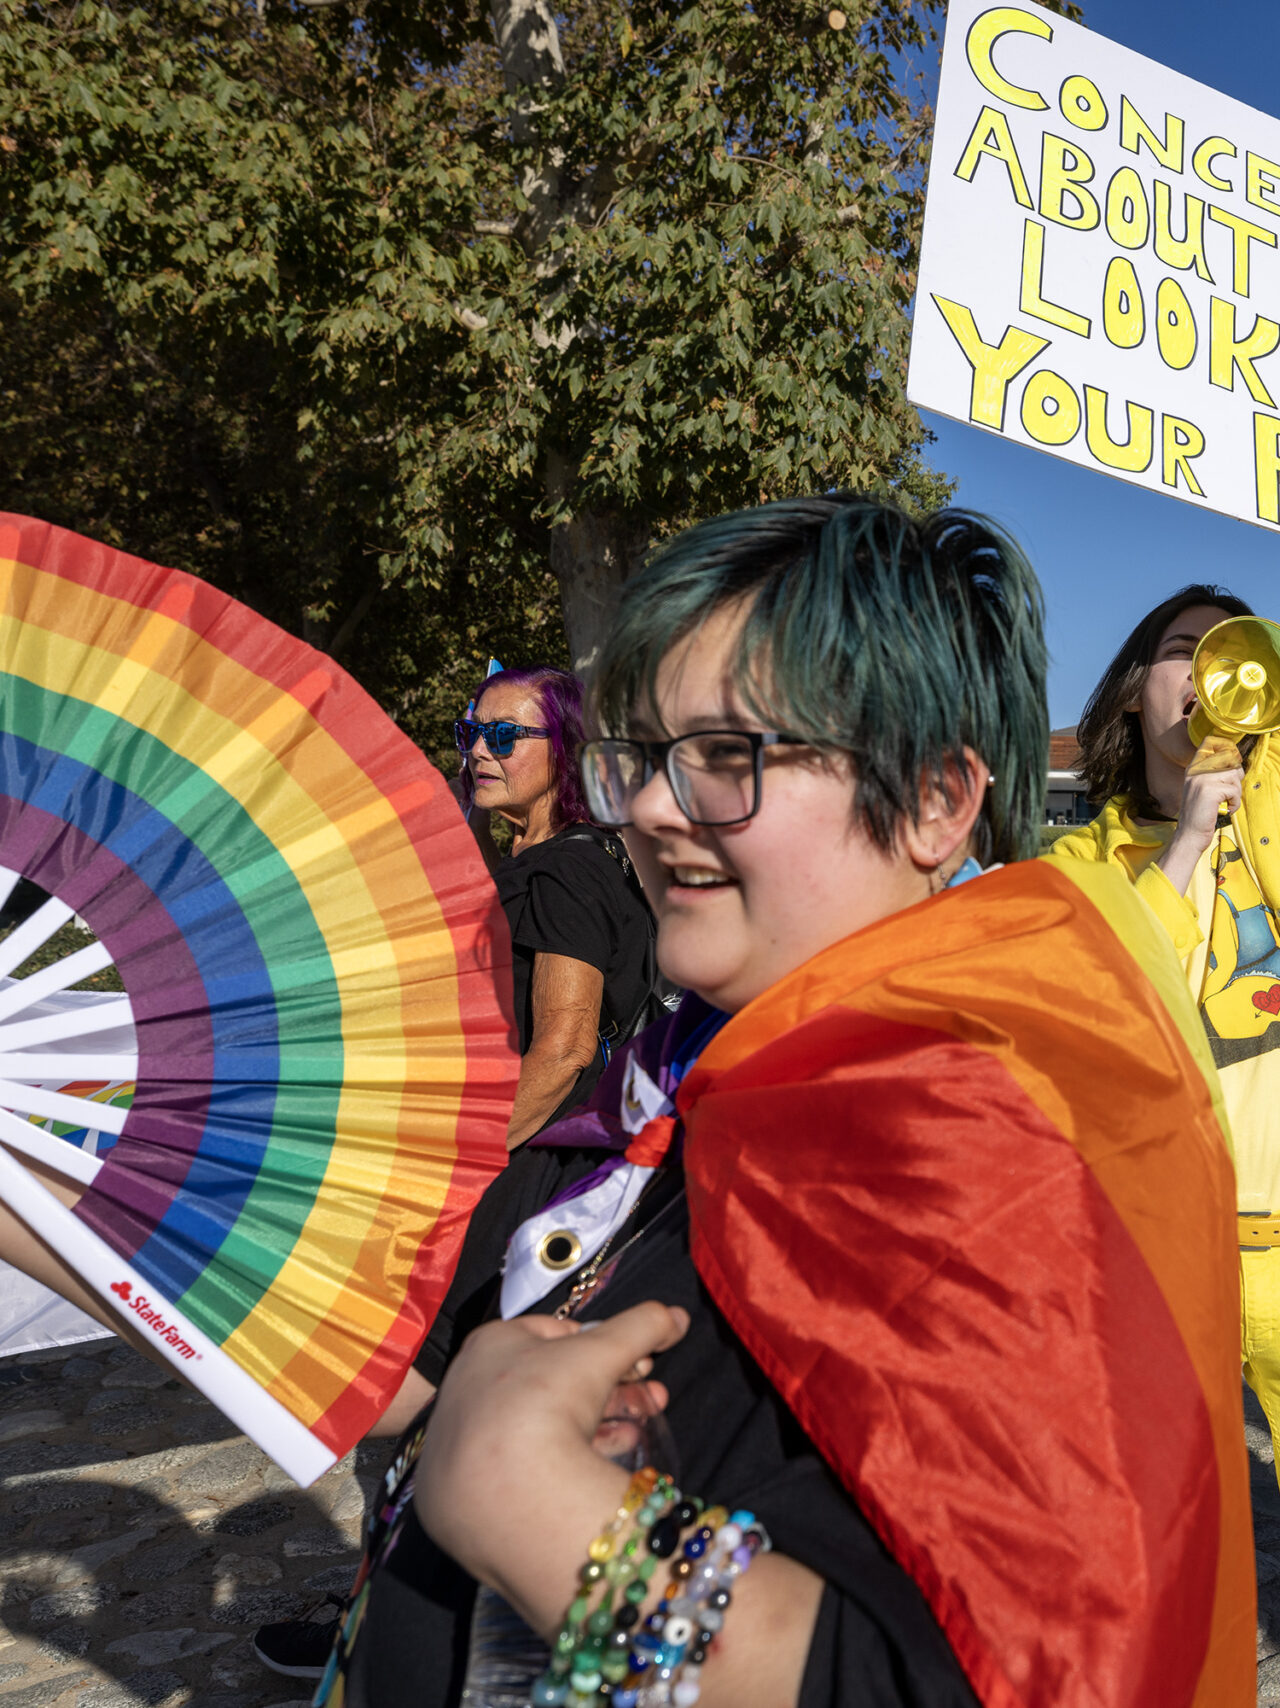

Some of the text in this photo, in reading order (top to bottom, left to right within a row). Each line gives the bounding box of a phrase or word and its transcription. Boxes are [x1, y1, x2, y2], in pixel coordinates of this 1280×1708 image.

[954, 106, 1278, 297] ABOUT
[931, 292, 1206, 498] YOUR
[1019, 219, 1280, 408] LOOK
